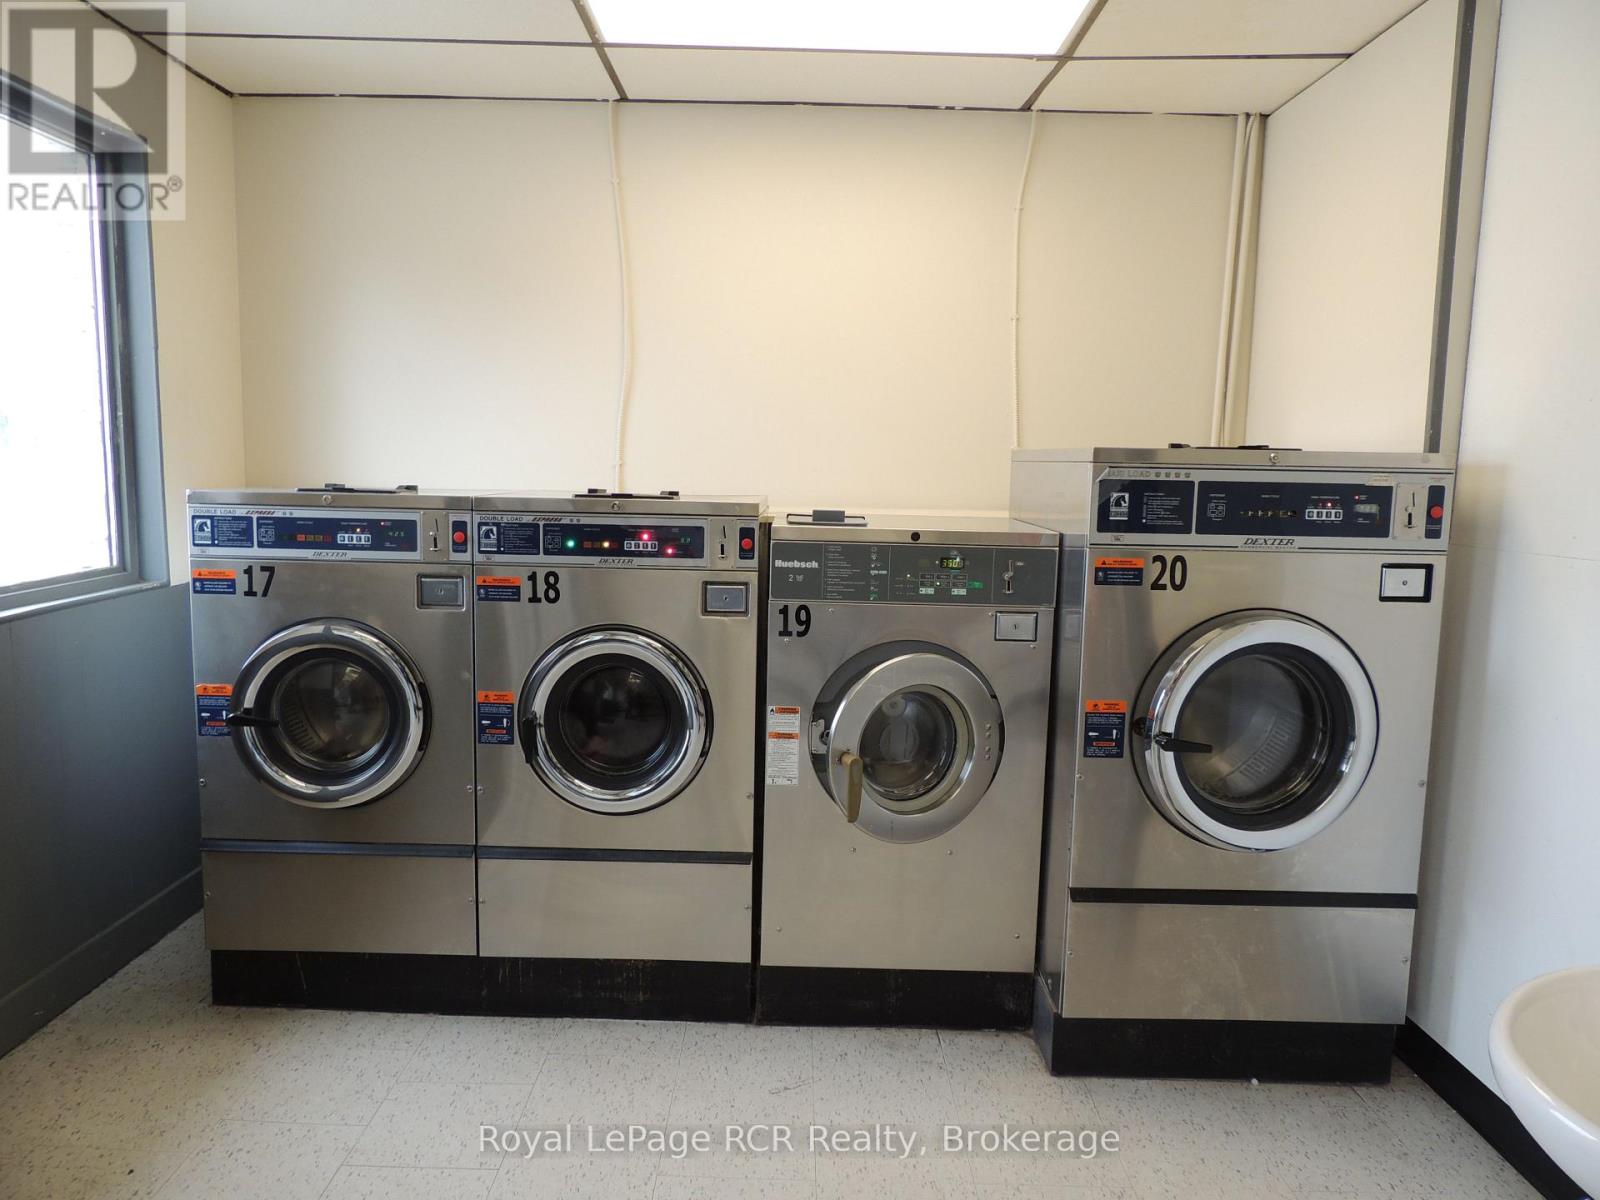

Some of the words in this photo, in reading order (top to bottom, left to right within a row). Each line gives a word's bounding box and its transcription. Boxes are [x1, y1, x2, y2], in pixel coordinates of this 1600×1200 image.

[1243, 537, 1295, 546] DEXTER
[242, 564, 276, 598] 17
[774, 559, 819, 569] Huebsch
[1150, 554, 1188, 592] 20
[527, 570, 561, 604] 18
[778, 604, 812, 638] 19
